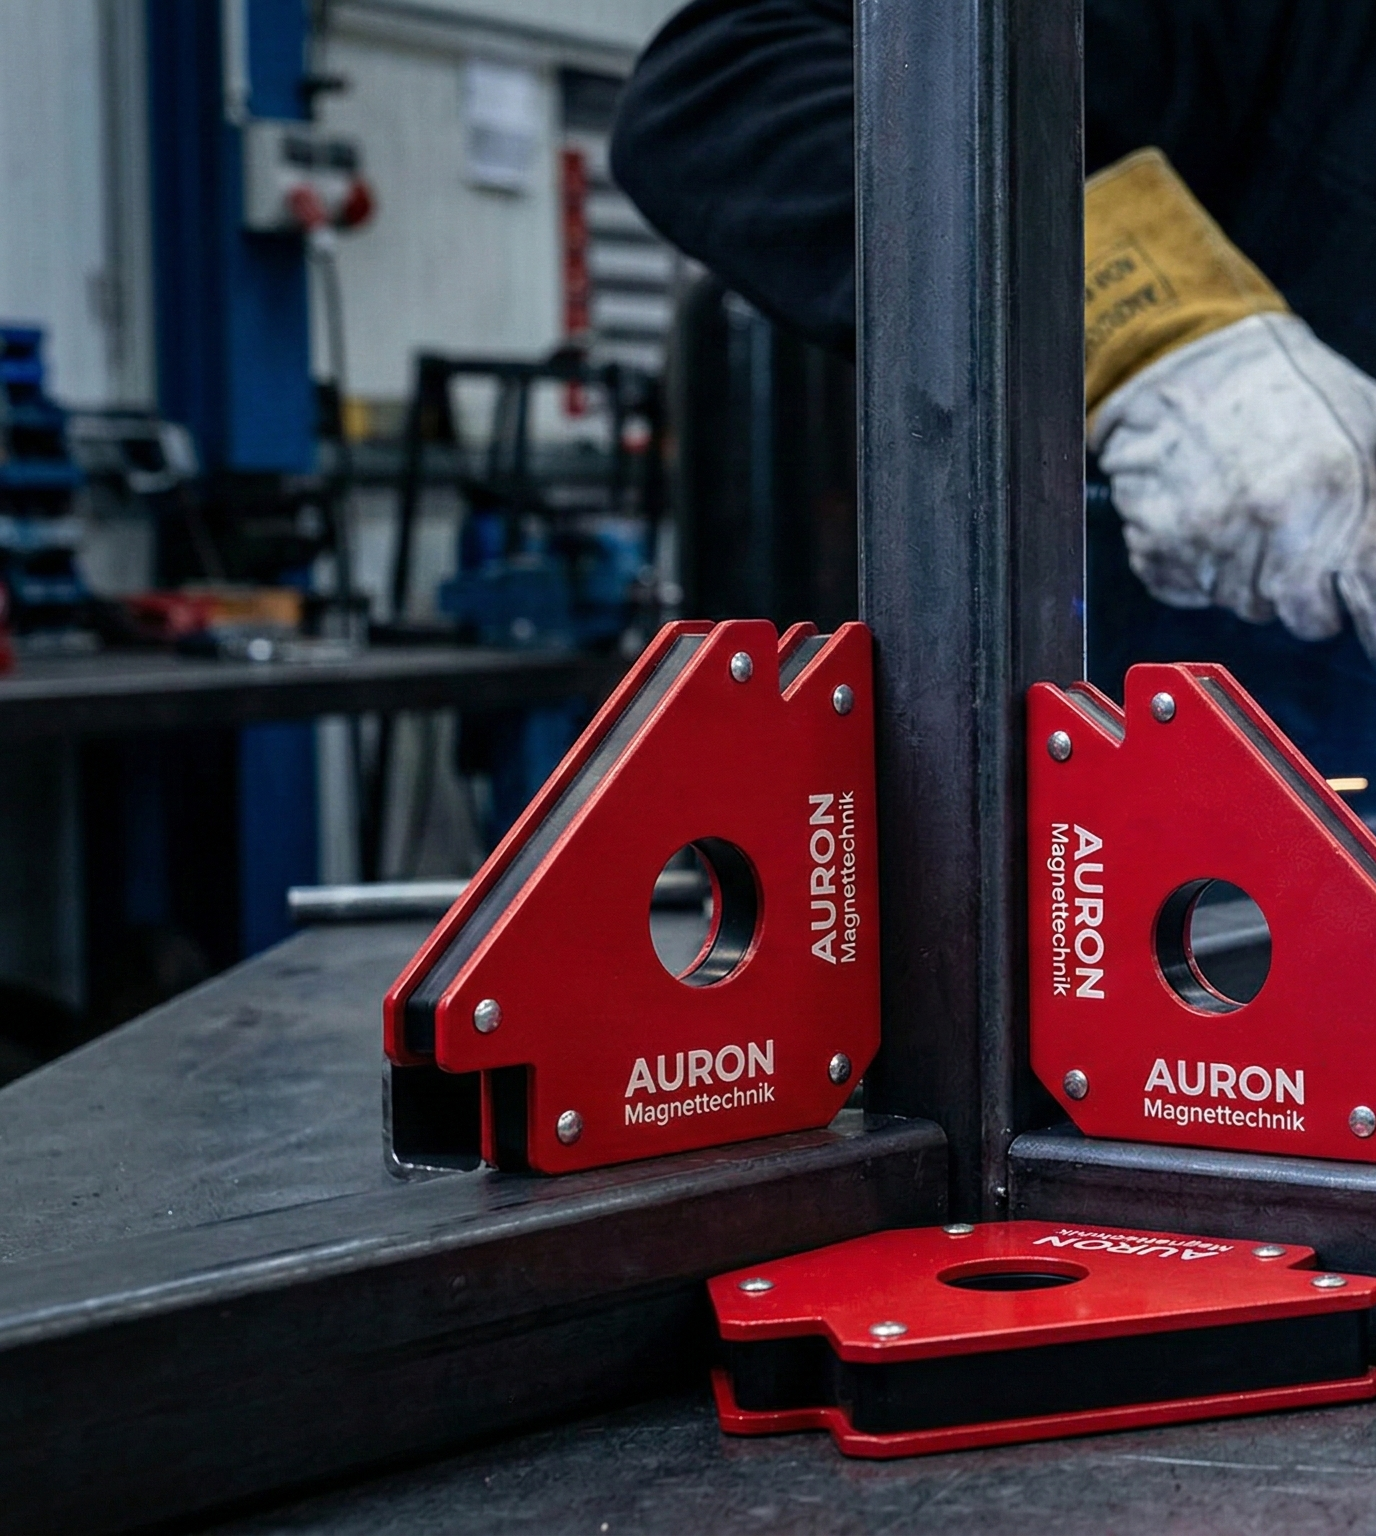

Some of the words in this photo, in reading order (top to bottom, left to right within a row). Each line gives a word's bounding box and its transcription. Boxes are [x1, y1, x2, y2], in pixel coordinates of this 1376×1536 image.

[808, 793, 837, 965] AURON
[838, 790, 861, 963] Magnettechnik
[1047, 823, 1071, 997] Magnettechnik
[1073, 824, 1105, 1000] AURON
[624, 1039, 774, 1098] AURON
[1144, 1058, 1305, 1105] AURON
[624, 1082, 775, 1126] Magnettechnik
[1143, 1098, 1306, 1132] Magnettechnik
[1033, 1235, 1220, 1261] AURON
